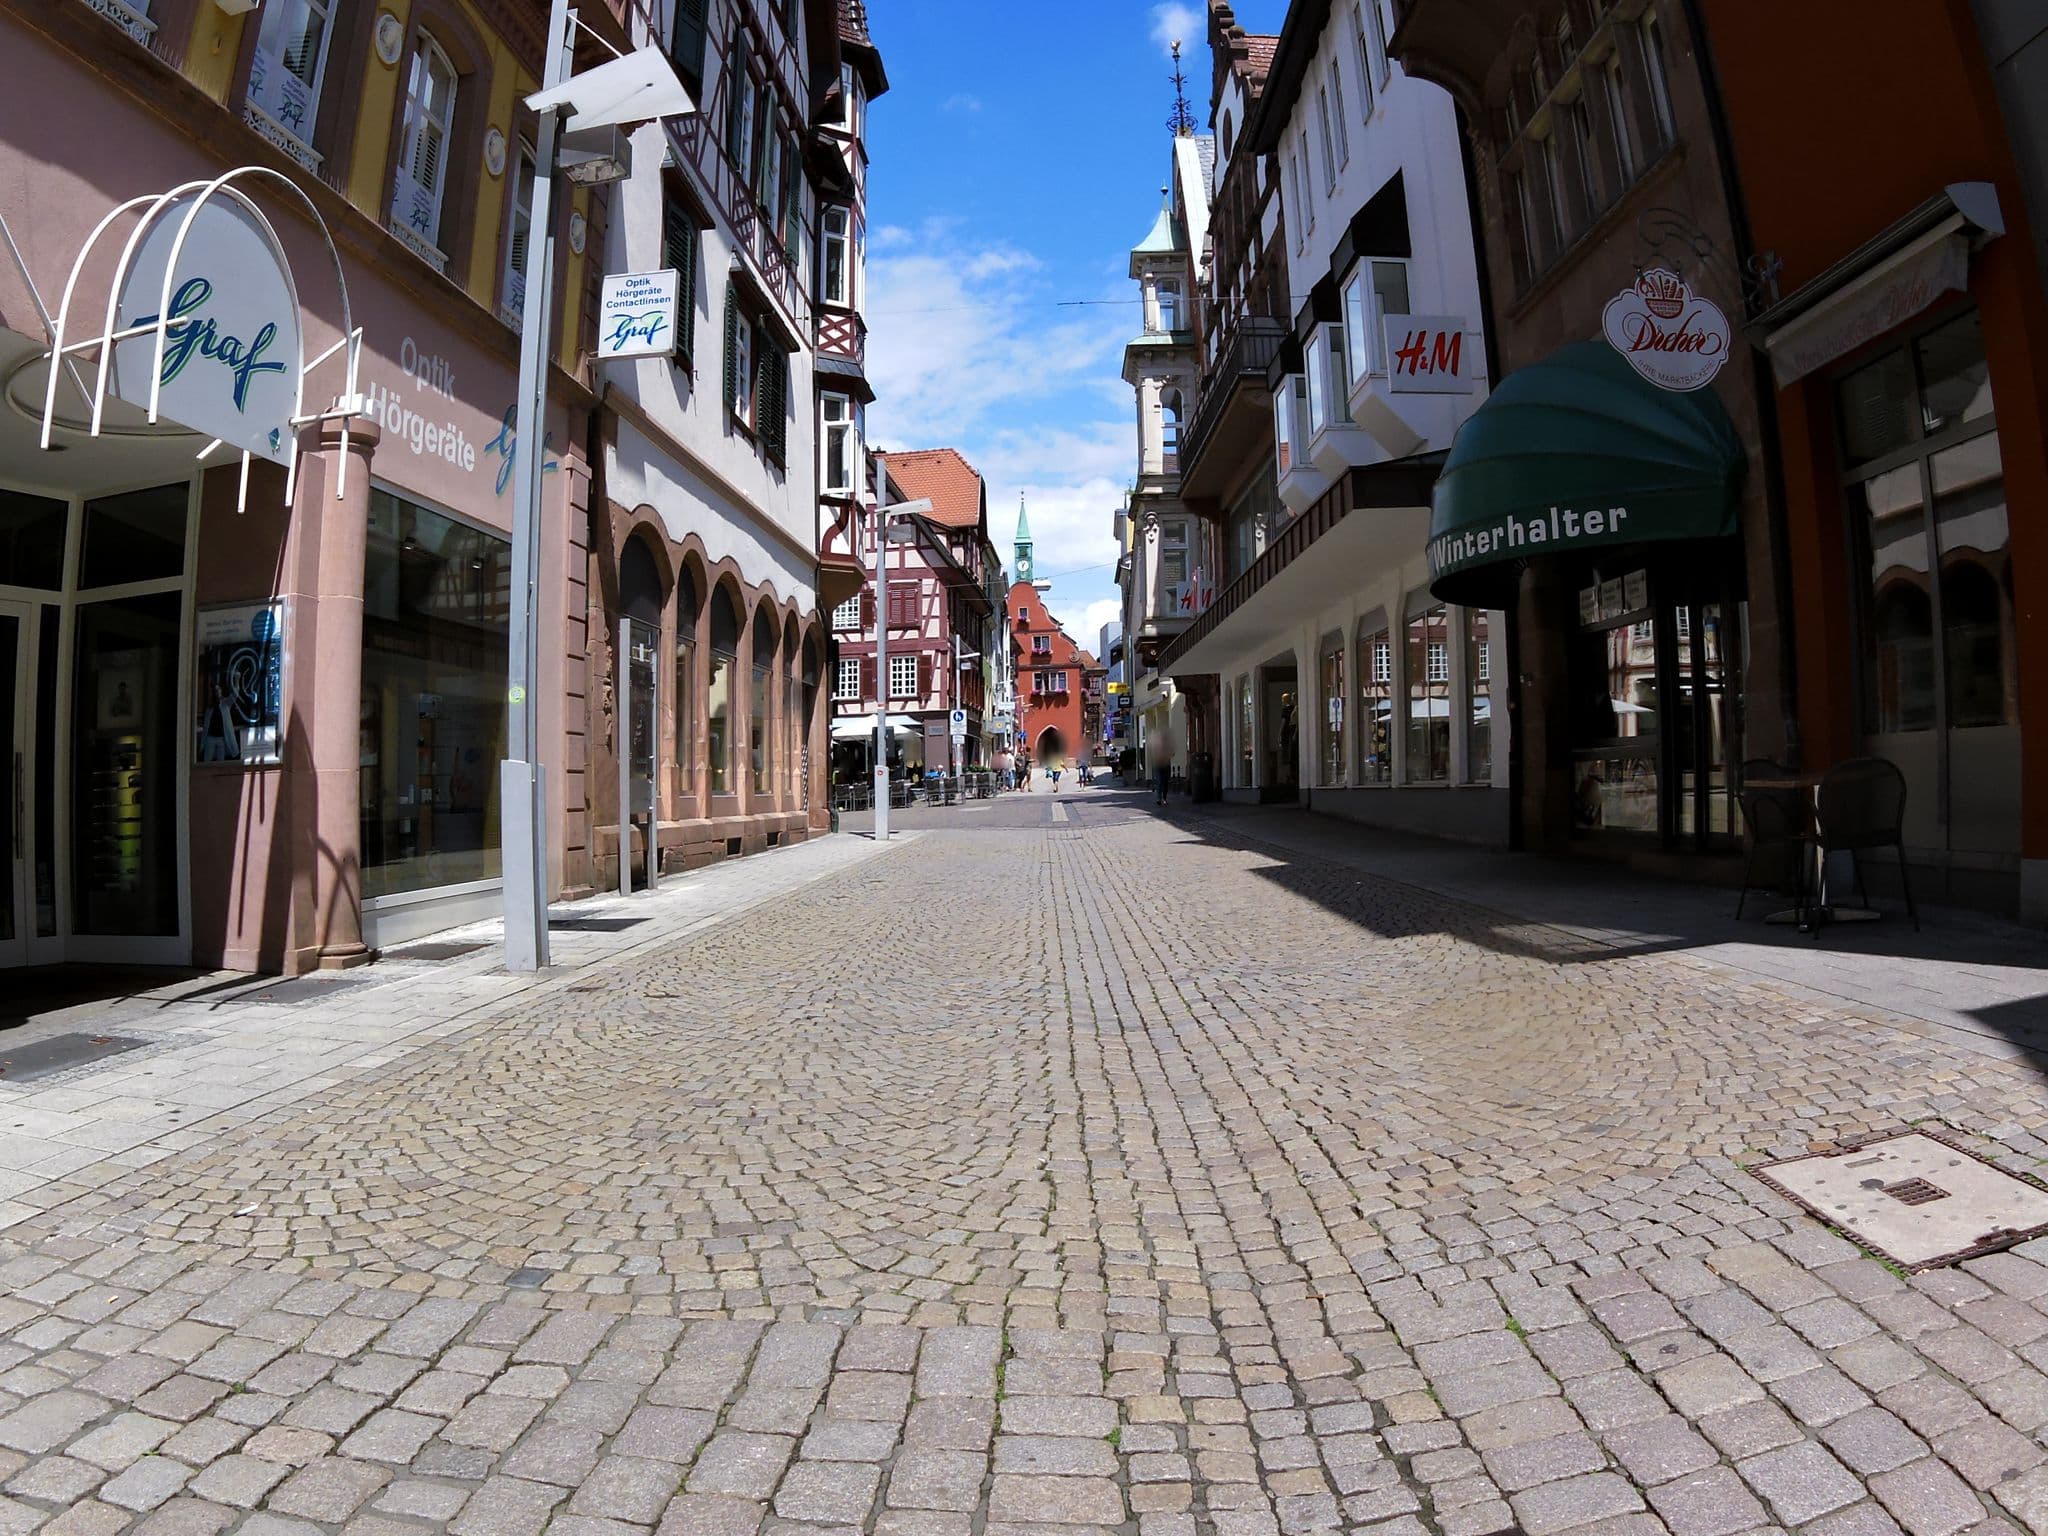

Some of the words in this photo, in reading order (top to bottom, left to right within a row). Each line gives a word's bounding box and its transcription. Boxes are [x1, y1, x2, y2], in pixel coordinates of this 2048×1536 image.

[606, 296, 671, 309] Contactlinsen
[615, 287, 662, 299] Hörgeräte
[625, 277, 651, 289] Optik
[130, 277, 287, 415] Graf
[603, 316, 669, 351] Graf
[1394, 329, 1462, 377] H&M
[1621, 310, 1722, 356] Dreher
[400, 336, 456, 404] Optik
[369, 381, 476, 473] Hörgeräte
[1432, 506, 1628, 574] Winterhalter
